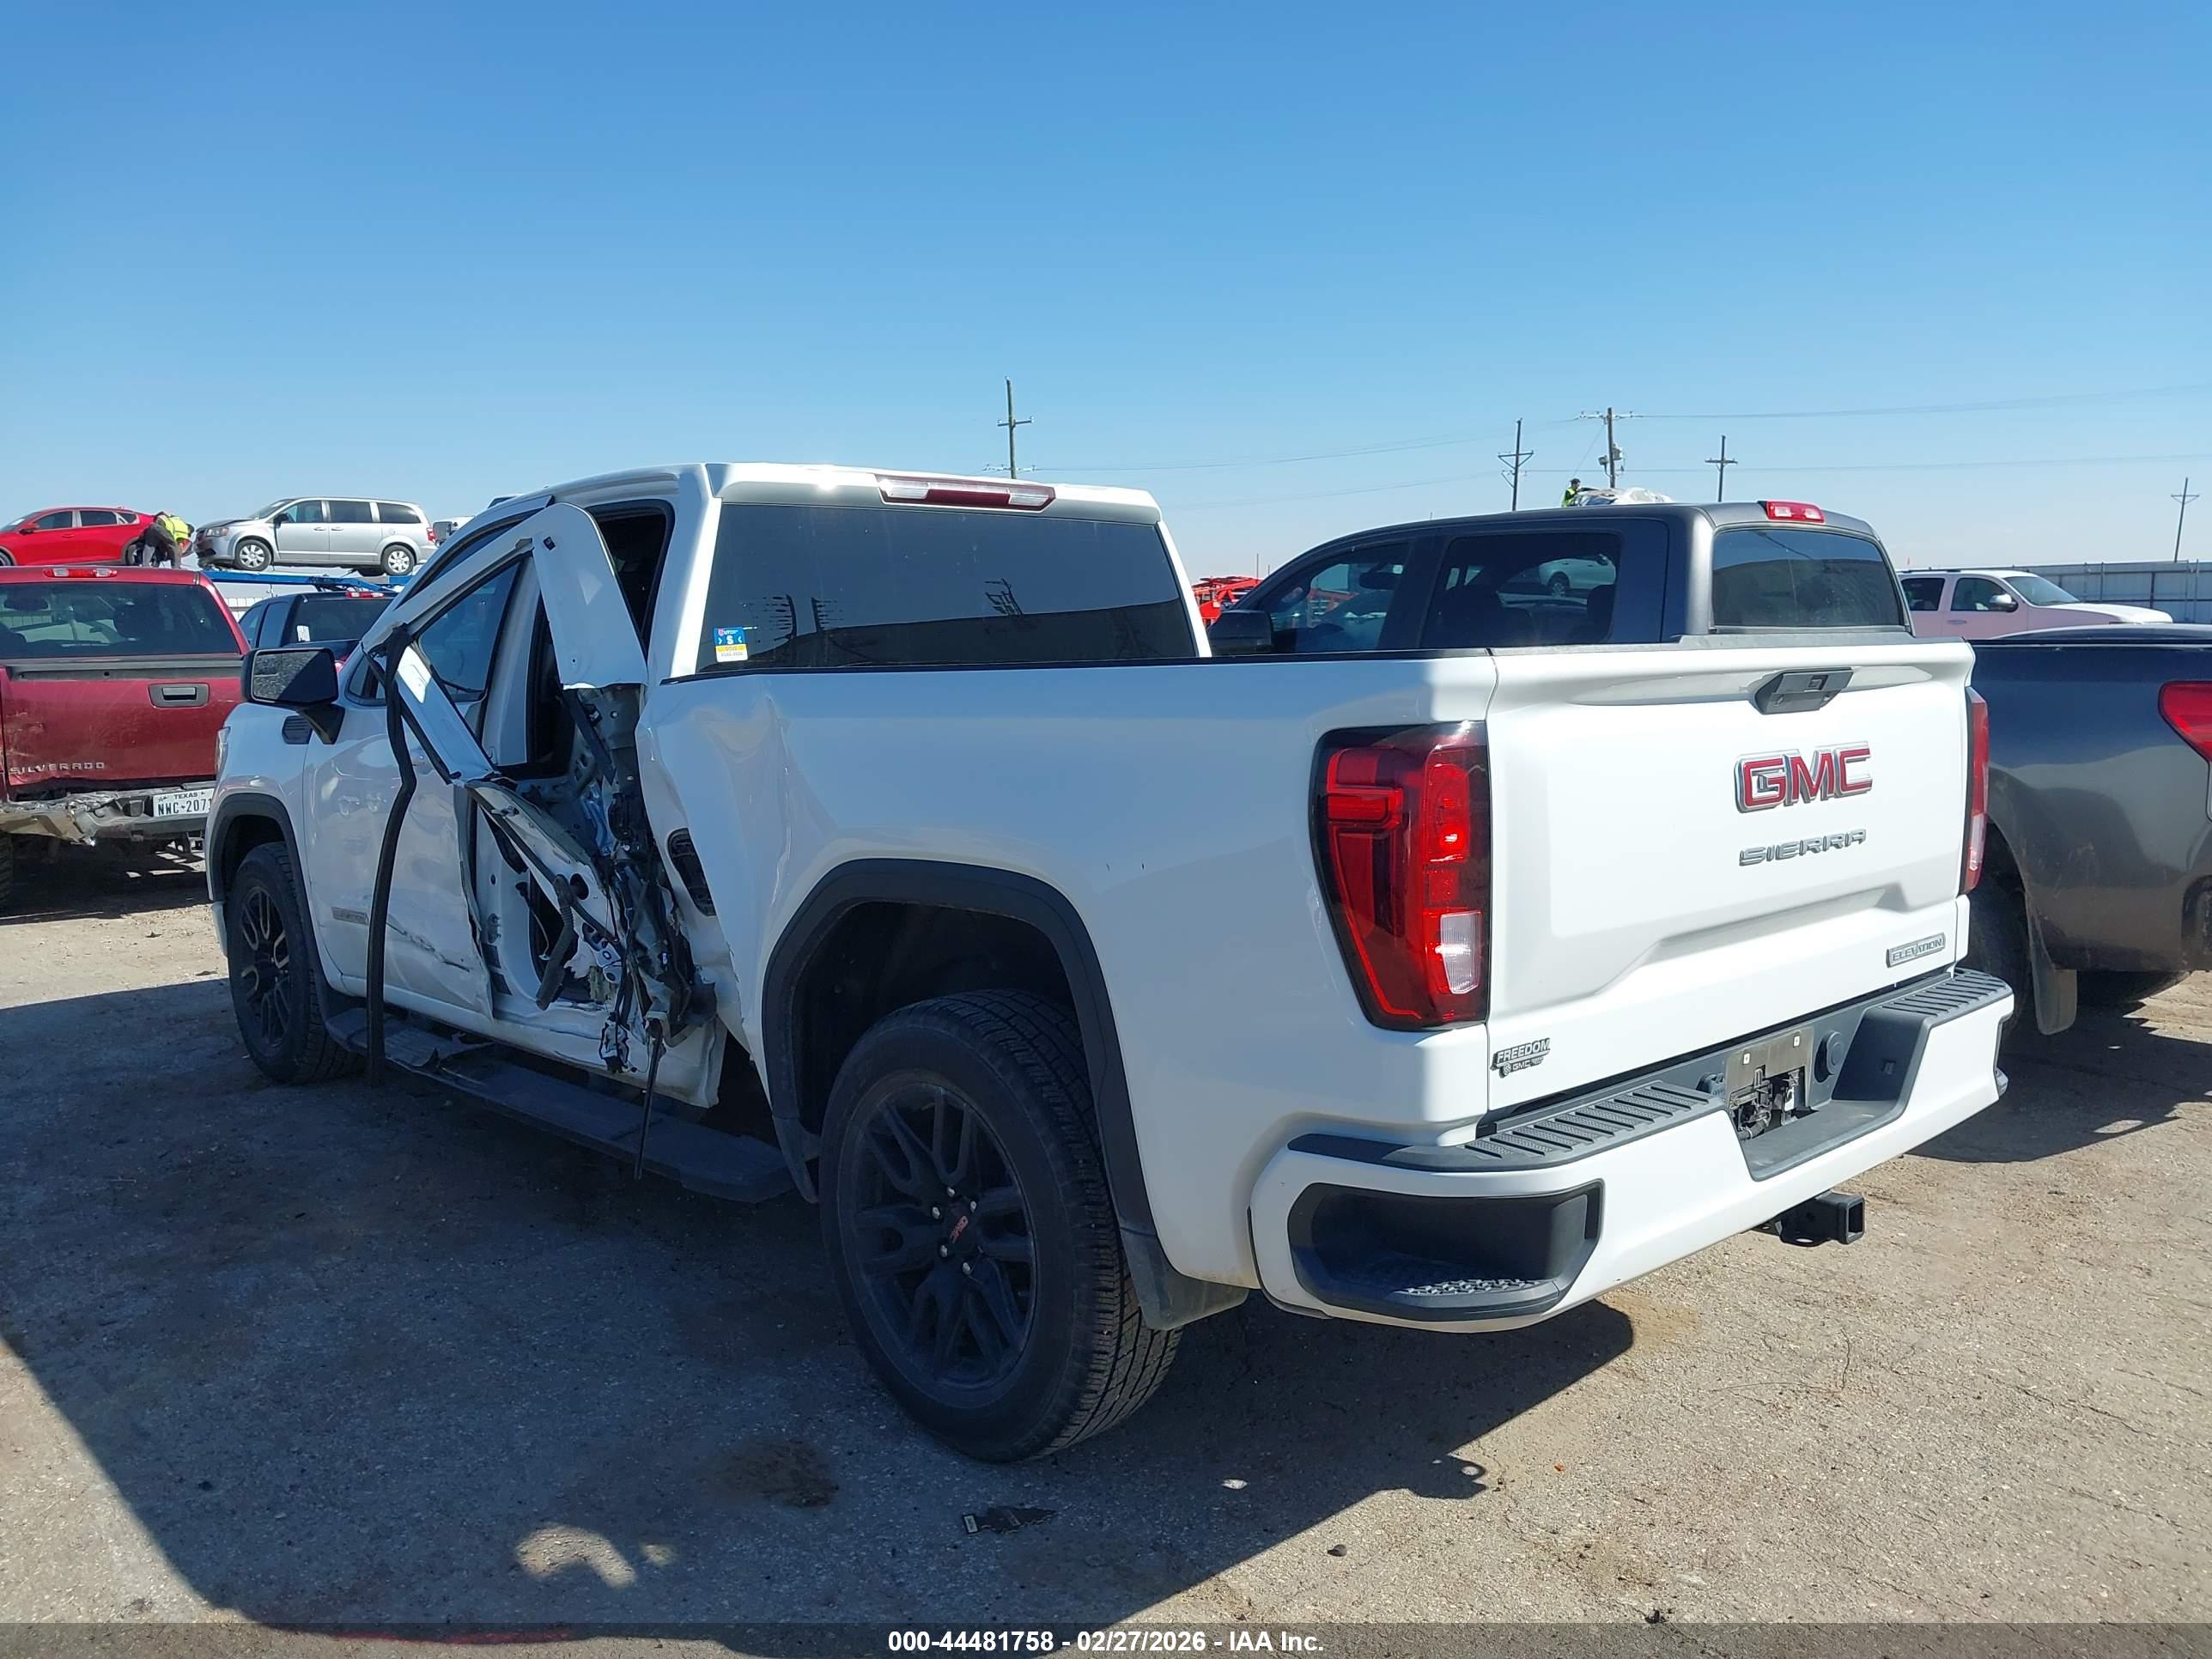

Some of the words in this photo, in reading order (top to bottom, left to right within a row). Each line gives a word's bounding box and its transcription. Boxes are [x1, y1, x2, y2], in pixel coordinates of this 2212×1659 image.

[9, 762, 105, 775] SILVERADO
[1735, 742, 1872, 813] GMC
[1739, 829, 1867, 866] SIERRA
[1891, 938, 1943, 962] ELEVATION
[1495, 1037, 1551, 1064] FREEDOM
[1511, 1059, 1531, 1072] GMC
